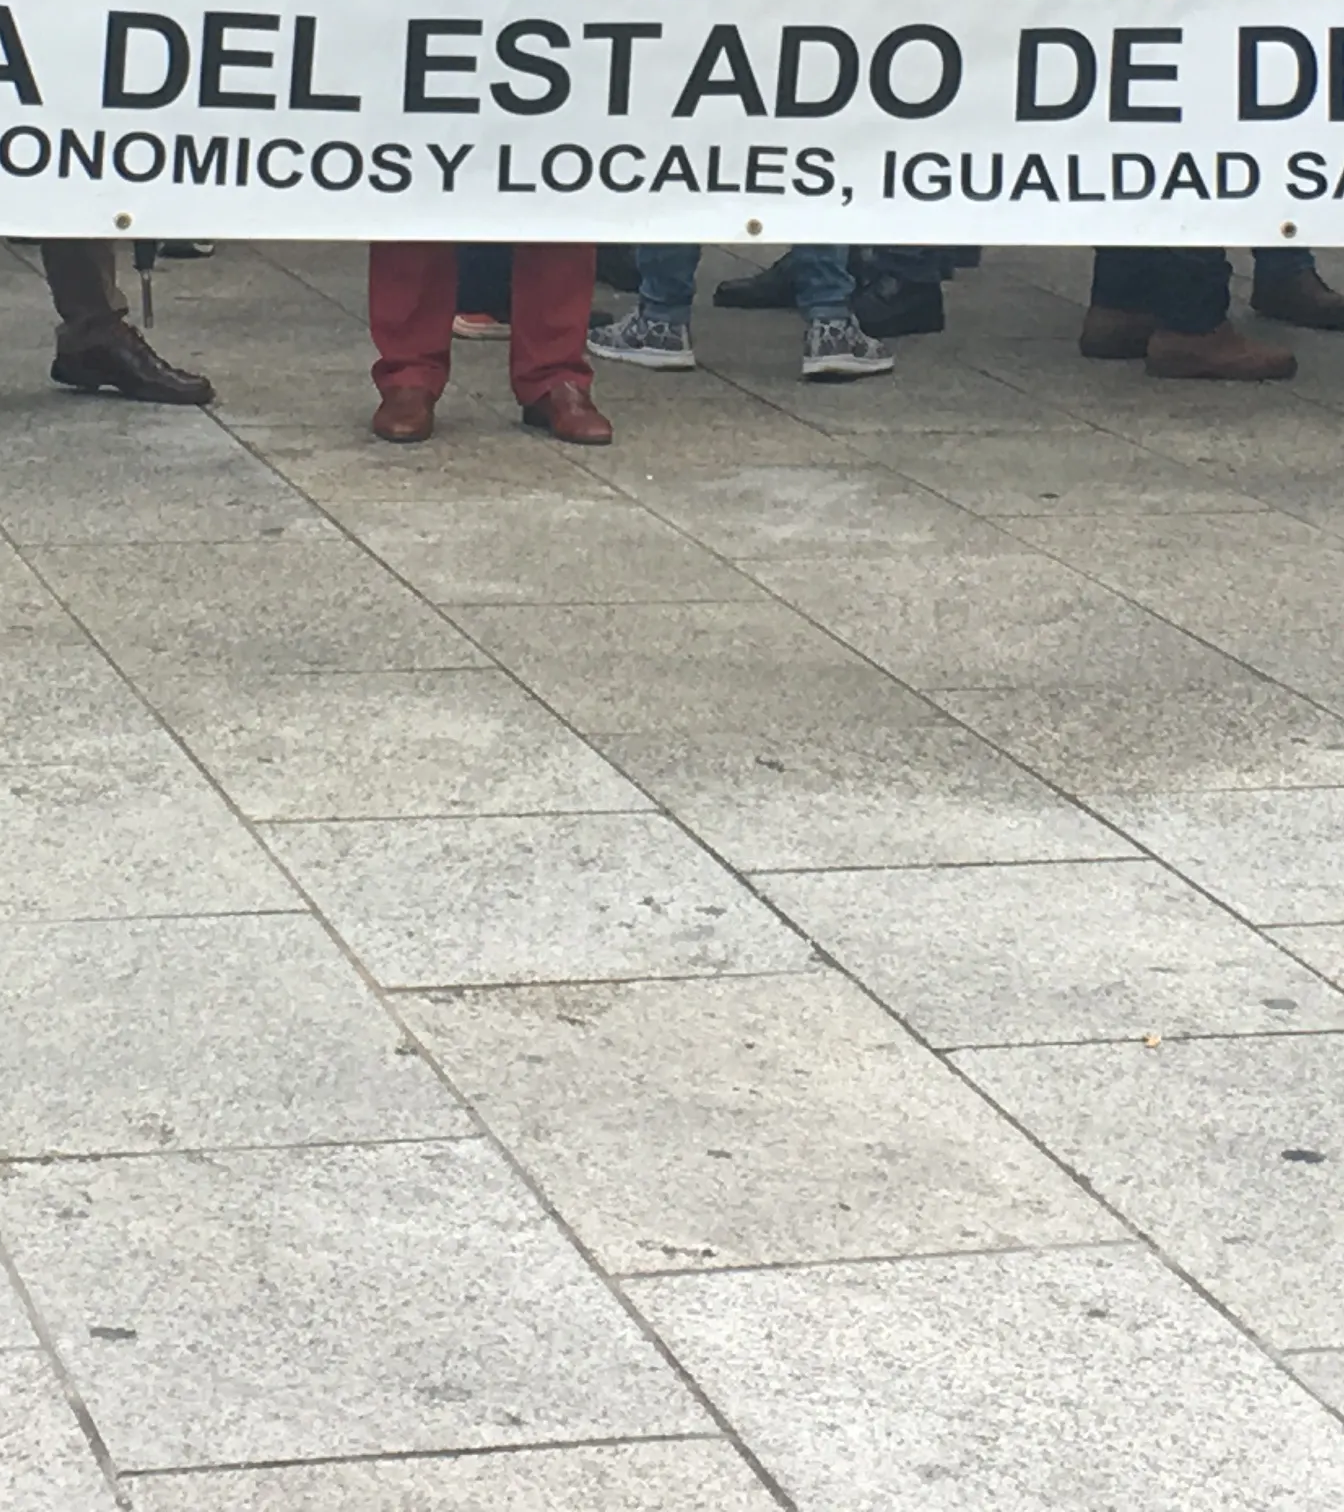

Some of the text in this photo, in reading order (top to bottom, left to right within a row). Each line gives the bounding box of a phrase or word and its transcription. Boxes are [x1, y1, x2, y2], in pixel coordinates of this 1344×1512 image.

[102, 11, 361, 112] DEL
[404, 19, 962, 119] ESTADO
[1016, 28, 1182, 122] DE
[427, 144, 473, 192] Y
[499, 144, 854, 205] LOCALES,
[884, 151, 1260, 202] IGUALDAD
